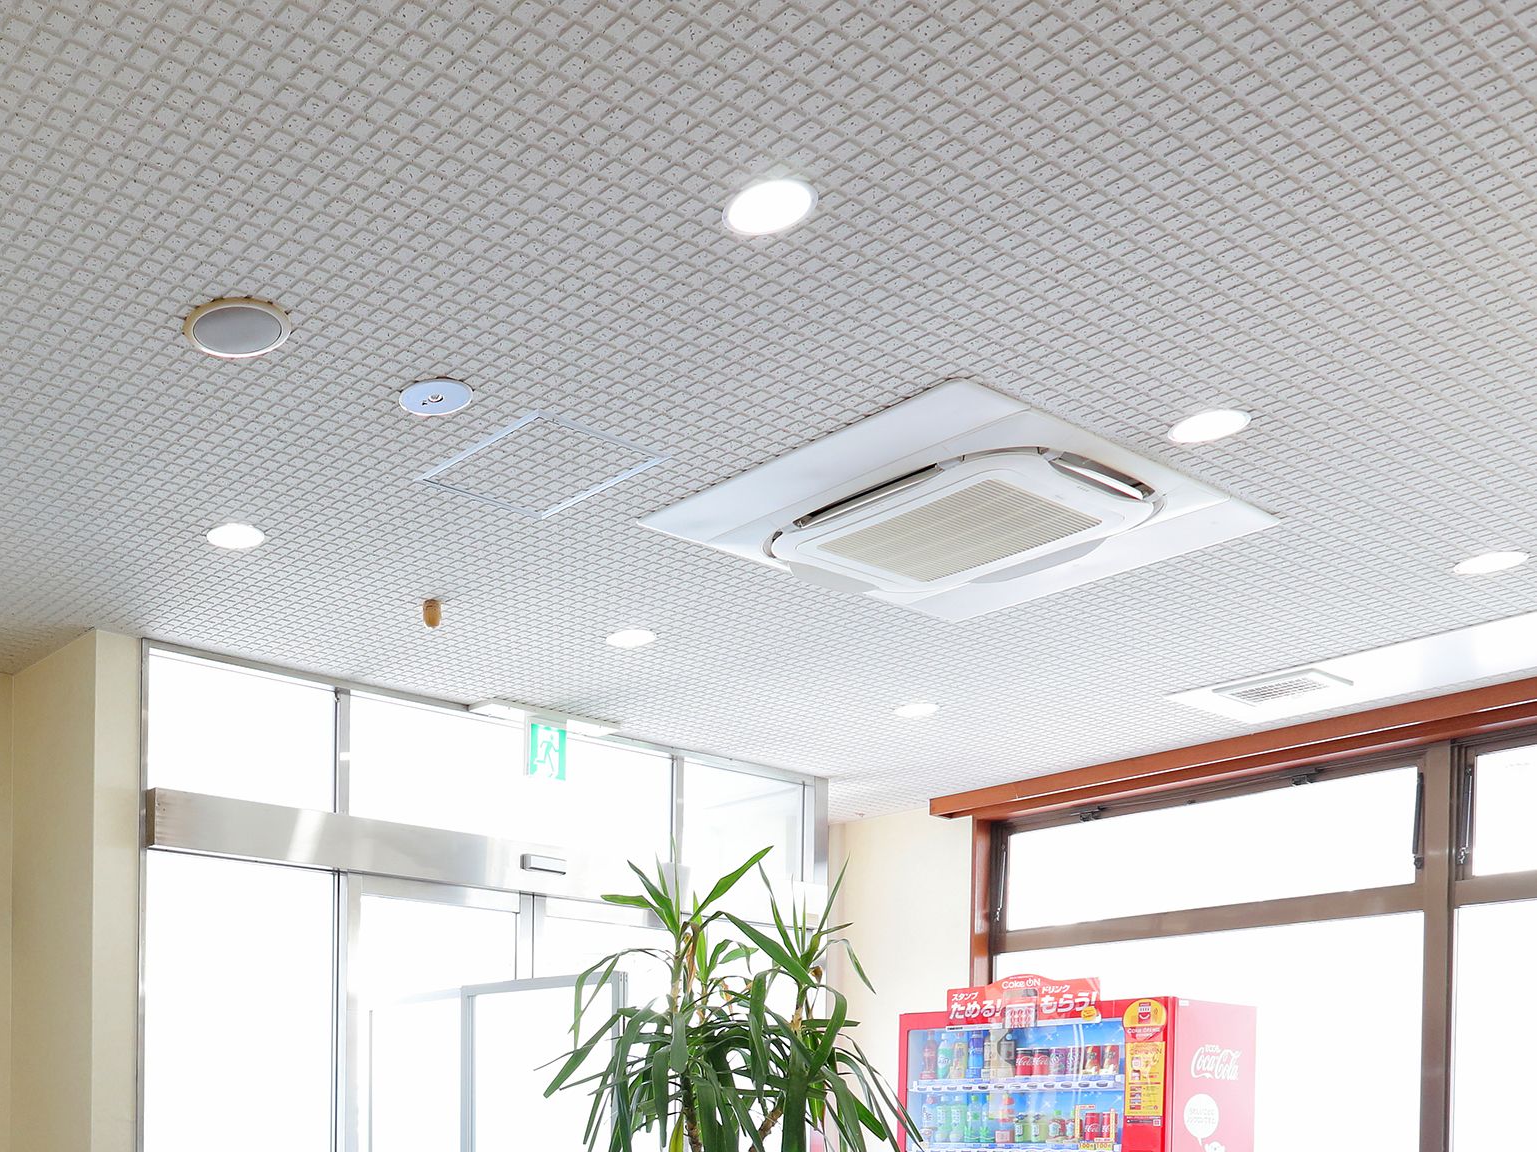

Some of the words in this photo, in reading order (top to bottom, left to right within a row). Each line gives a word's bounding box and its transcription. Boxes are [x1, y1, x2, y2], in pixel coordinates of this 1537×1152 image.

[1002, 979, 1025, 989] Coke
[1026, 977, 1040, 988] ON
[1042, 984, 1070, 994] ドリンク
[952, 992, 978, 1001] スタンプ
